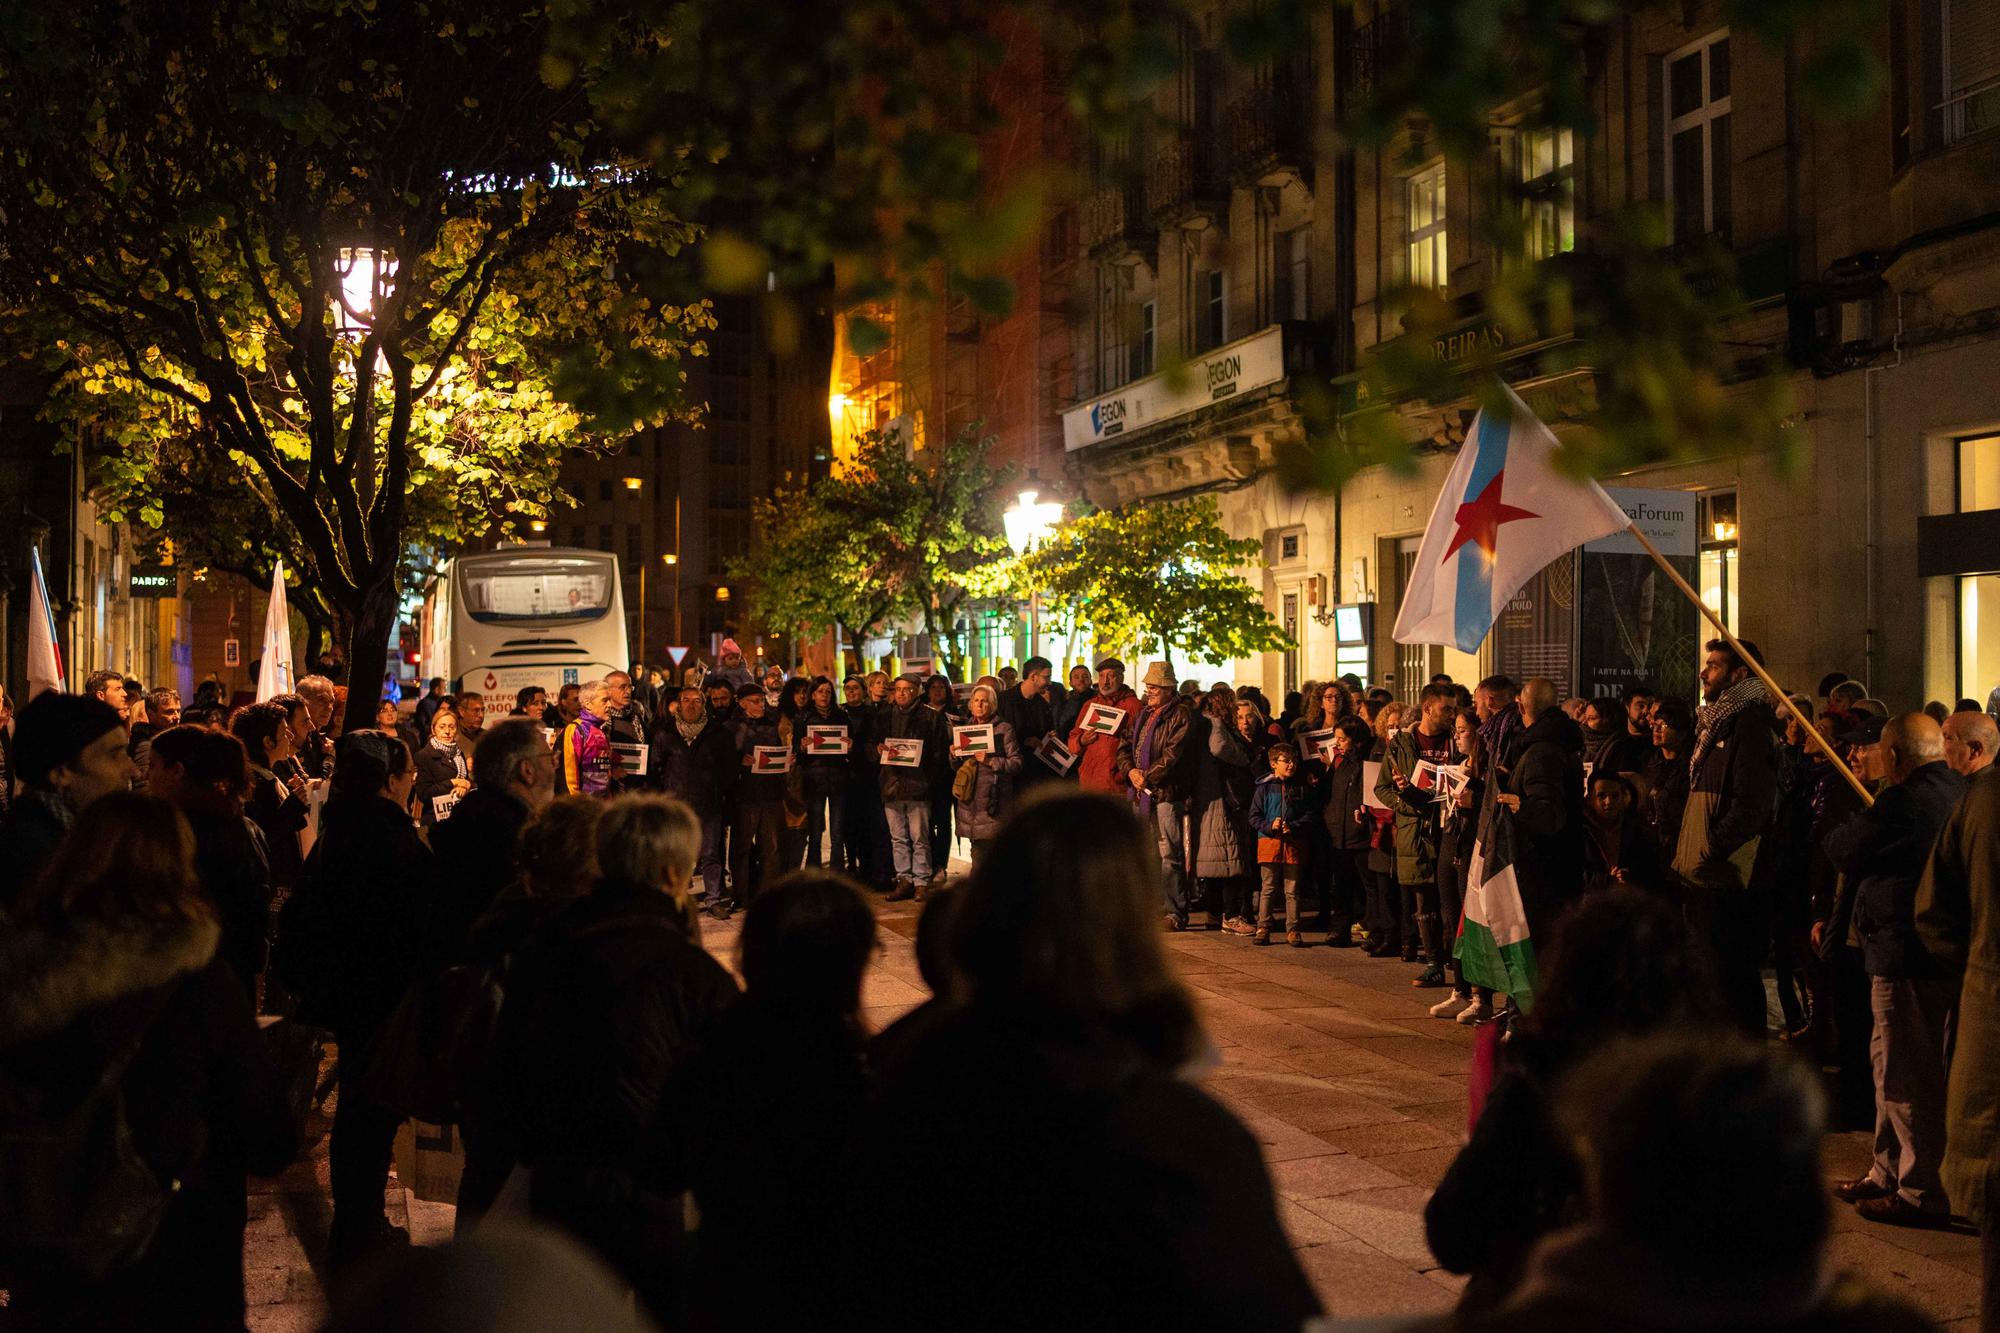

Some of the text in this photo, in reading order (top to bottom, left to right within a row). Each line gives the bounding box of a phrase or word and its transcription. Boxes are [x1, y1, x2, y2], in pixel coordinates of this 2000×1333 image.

[1619, 503, 1684, 521] xaForum
[1598, 667, 1618, 676] ARTE
[1620, 667, 1631, 676] NA
[487, 703, 512, 713] 900
